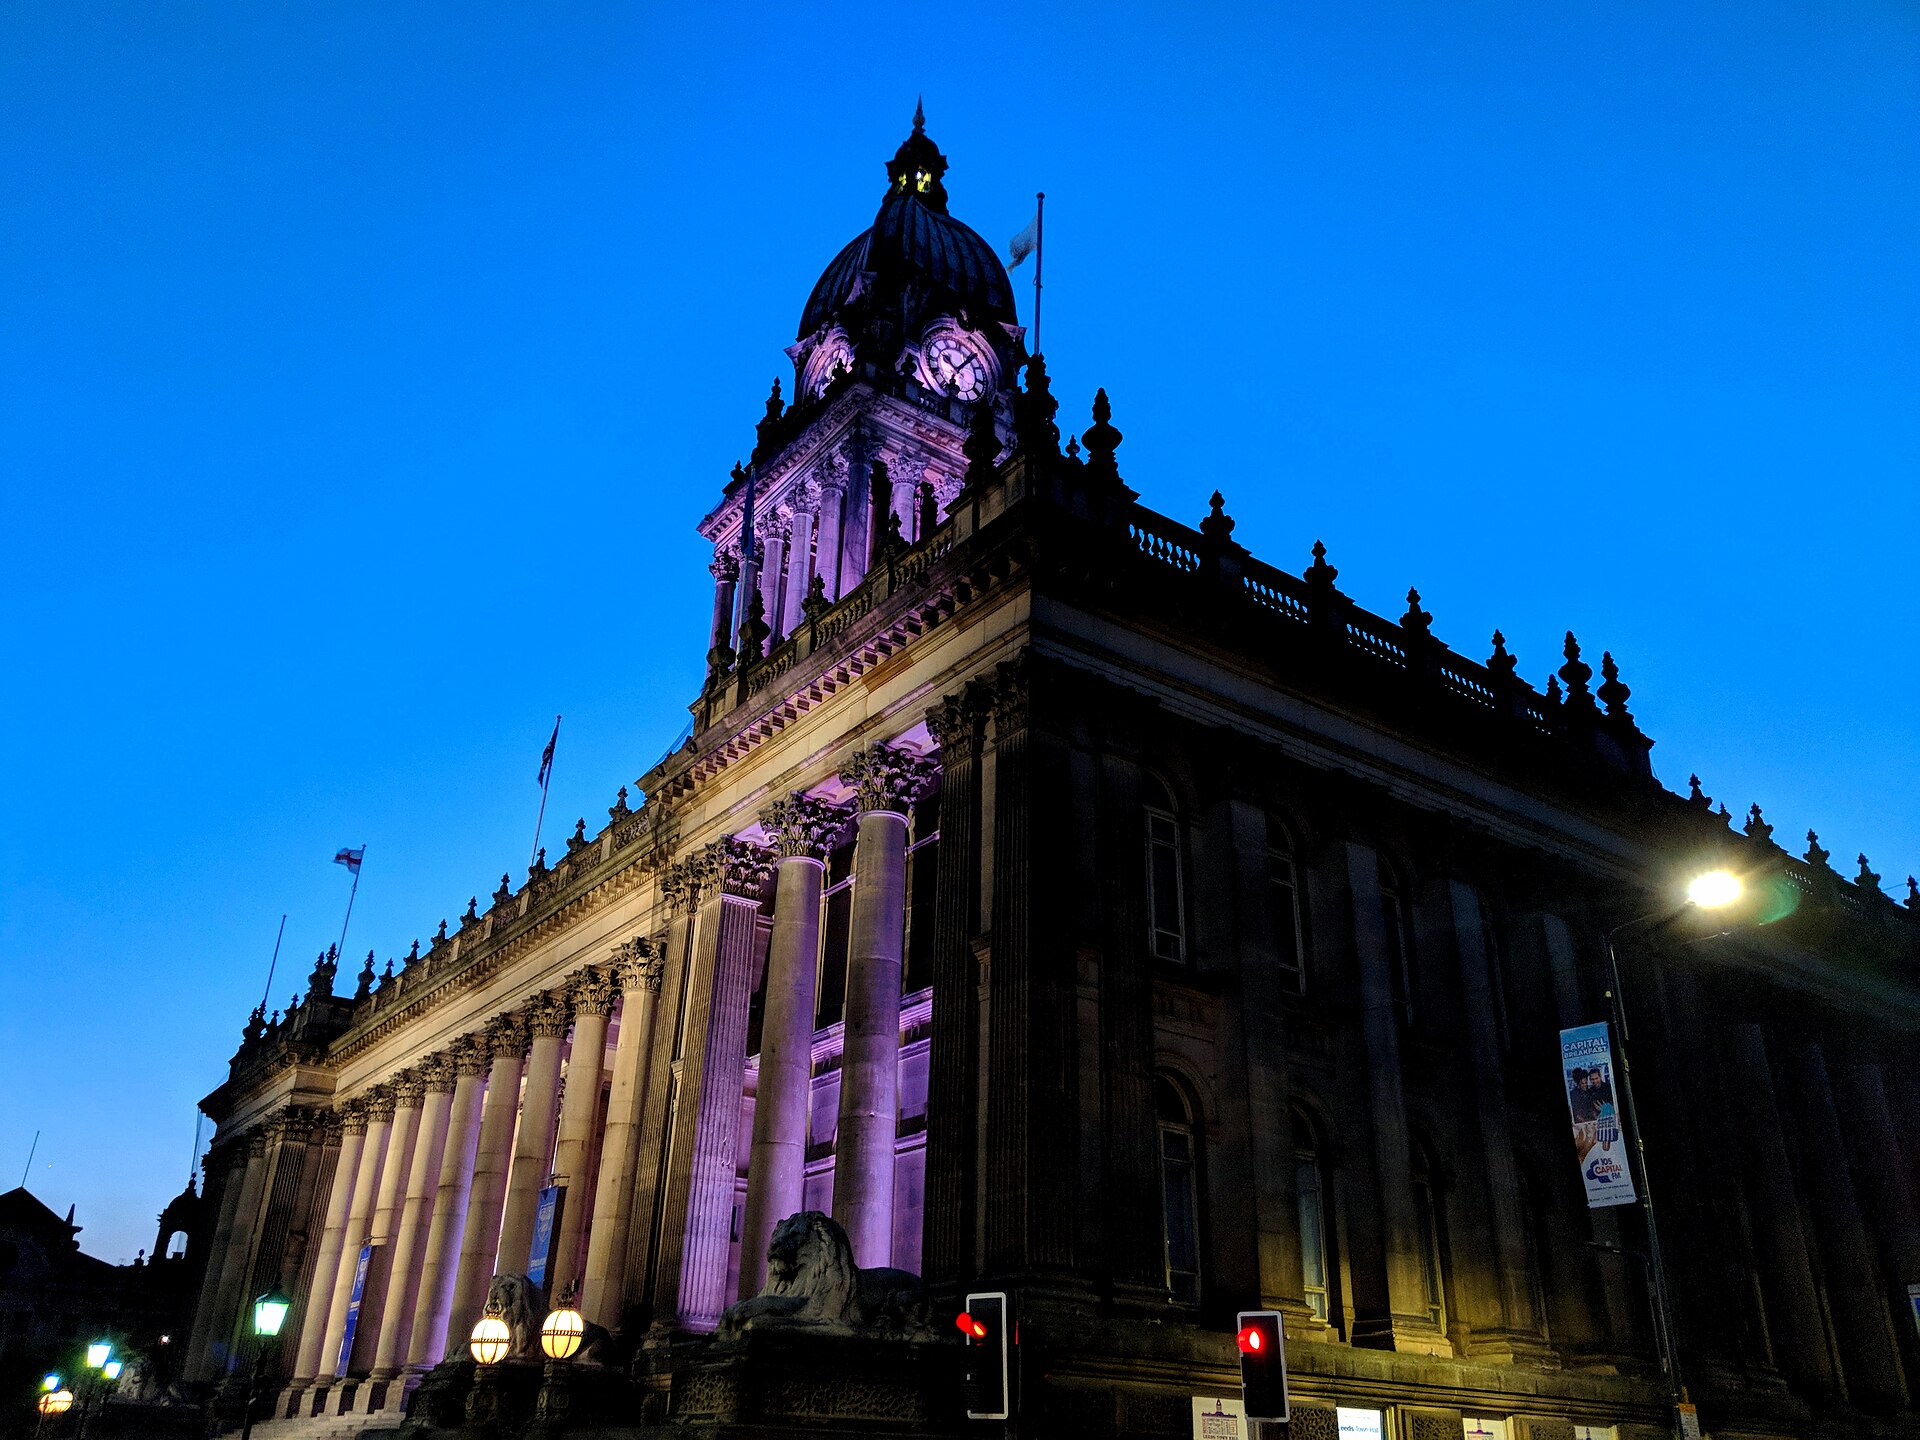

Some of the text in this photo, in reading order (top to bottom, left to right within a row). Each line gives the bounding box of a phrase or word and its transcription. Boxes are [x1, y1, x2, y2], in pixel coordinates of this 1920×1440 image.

[1563, 1038, 1606, 1051] CAPITAL
[1564, 1046, 1607, 1058] BREAKFAST
[1601, 1158, 1613, 1166] 105
[1595, 1165, 1622, 1174] CAPITAL
[1612, 1172, 1621, 1180] FM
